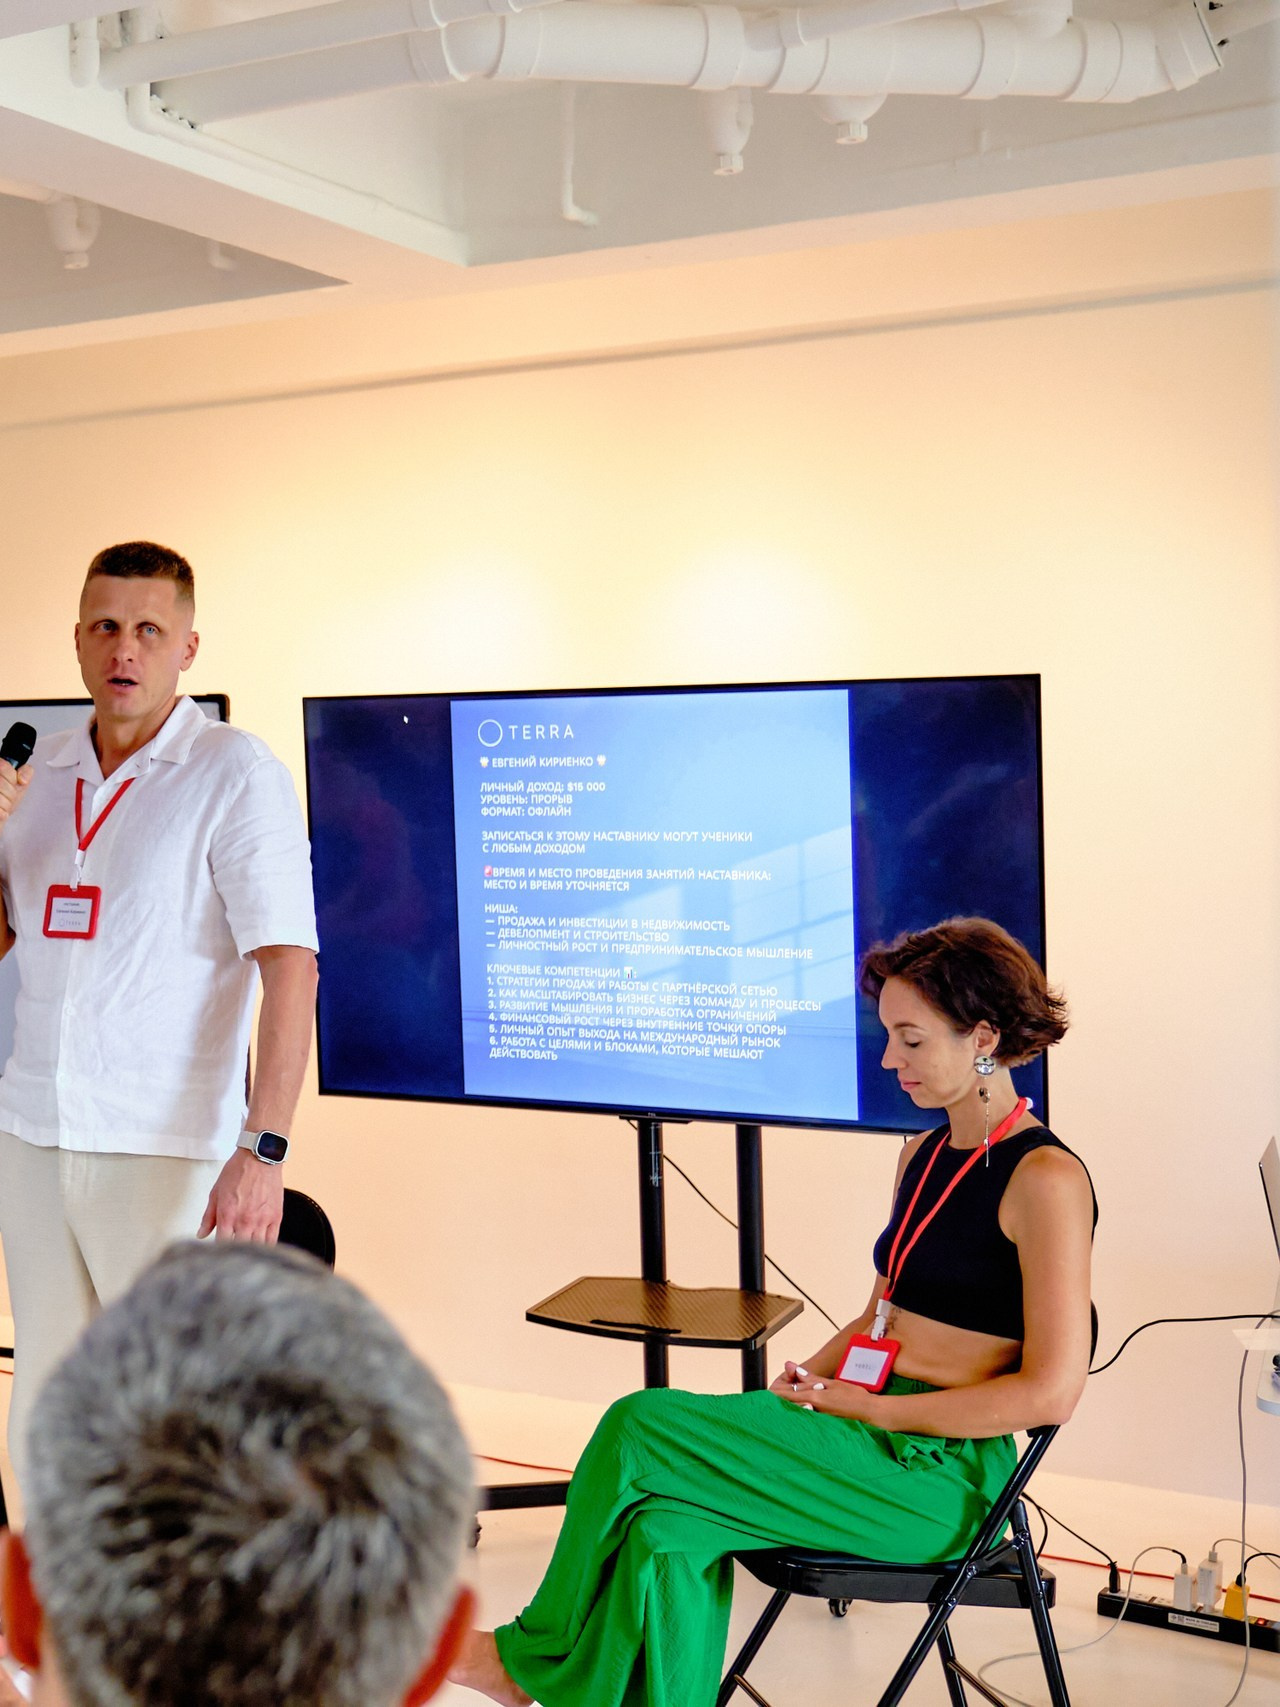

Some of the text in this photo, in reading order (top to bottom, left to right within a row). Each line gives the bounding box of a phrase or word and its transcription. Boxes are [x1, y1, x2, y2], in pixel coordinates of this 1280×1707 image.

[508, 724, 573, 740] TERRA
[491, 755, 593, 767] ЕВГЕНИЙ КИРИЕНКО
[480, 780, 524, 792] ЛИЧНЫЙ
[526, 782, 563, 793] ДОХОД:
[586, 782, 605, 791] 000
[480, 794, 572, 804] УРОВЕНЬ: ПРОРЫВ
[480, 804, 571, 816] ФОРМАТ: ОФЛАЙН
[481, 831, 752, 841] ЗАПИСАТЬСЯ К ЭТОМУ НАСТАВНИКУ МОГУТ УЧЕНИКИ
[481, 843, 585, 854] С ЛЮБЫМ ДОХОДОМ
[492, 867, 771, 880] ВРЕМЯ И МЕСТО ПРОВЕДЕНИЯ ЗАНЯТИЙ НАСТАВНИКА:
[483, 879, 629, 891] МЕСТО И ВРЕМЯ УТОЧНЯЕТСЯ
[483, 903, 518, 913] НИША:
[497, 916, 545, 928] ПРОДАЖА
[548, 917, 555, 926] И
[558, 917, 627, 928] ИНВЕСТИЦИИ
[631, 919, 638, 928] В
[641, 919, 730, 930] НЕДВИЖИМОСТЬ
[497, 928, 570, 939] ДЕВЕЛОПМЕНТ
[572, 930, 581, 939] И
[583, 930, 669, 942] СТРОИТЕЛЬСТВО
[497, 939, 569, 951] ЛИЧНОСТНЫЙ
[571, 942, 598, 952] РОСТ
[599, 943, 609, 952] И
[611, 943, 743, 956] ПРЕДПРИНИМАТЕЛЬСКОЕ
[745, 947, 813, 958] МЫШЛЕНИЕ
[486, 963, 620, 977] КЛЮЧЕВЫЕ КОМПЕТЕНЦИИ
[495, 976, 549, 987] СТРАТЕГИИ
[552, 978, 595, 989] ПРОДАЖ
[597, 980, 606, 989] И
[608, 980, 649, 991] РАБОТЫ
[651, 982, 659, 991] С
[740, 985, 778, 996] СЕТЬЮ
[498, 988, 517, 998] КАК
[519, 989, 613, 1002] МАСШТАБИРОВАТЬ
[616, 993, 656, 1004] БИЗНЕС
[658, 995, 690, 1005] ЧЕРЕЗ
[693, 996, 746, 1008] КОМАНДУ
[749, 998, 758, 1008] И
[760, 999, 821, 1011] ПРОЦЕССЫ
[499, 1000, 548, 1011] РАЗВИТИЕ
[551, 1002, 612, 1014] МЫШЛЕНИЯ
[615, 1005, 624, 1015] И
[626, 1006, 693, 1018] ПРОРАБОТКА
[695, 1008, 776, 1021] ОГРАНИЧЕНИЙ
[499, 1012, 571, 1024] ФИНАНСОВЫЙ
[573, 1016, 600, 1026] РОСТ
[602, 1017, 633, 1027] ЧЕРЕЗ
[635, 1018, 703, 1031] ВНУТРЕННИЕ
[706, 1022, 743, 1033] ТОЧКИ
[745, 1023, 786, 1035] ОПОРЫ
[500, 1023, 543, 1035] ЛИЧНЫЙ
[546, 1026, 575, 1037] ОПЫТ
[578, 1028, 620, 1040] ВЫХОДА
[623, 1030, 637, 1040] НА
[640, 1031, 738, 1045] МЕЖДУНАРОДНЫЙ
[741, 1036, 779, 1047] РЫНОК
[488, 1046, 559, 1060] ДЕЙСТВОВАТЬ
[500, 1036, 536, 1047] РАБОТА
[538, 1038, 545, 1047] С
[548, 1039, 591, 1050] ЦЕЛЯМИ
[593, 1041, 601, 1050] И
[604, 1042, 658, 1055] БЛОКАМИ,
[661, 1045, 709, 1056] КОТОРЫЕ
[713, 1047, 763, 1059] МЕШАЮТ
